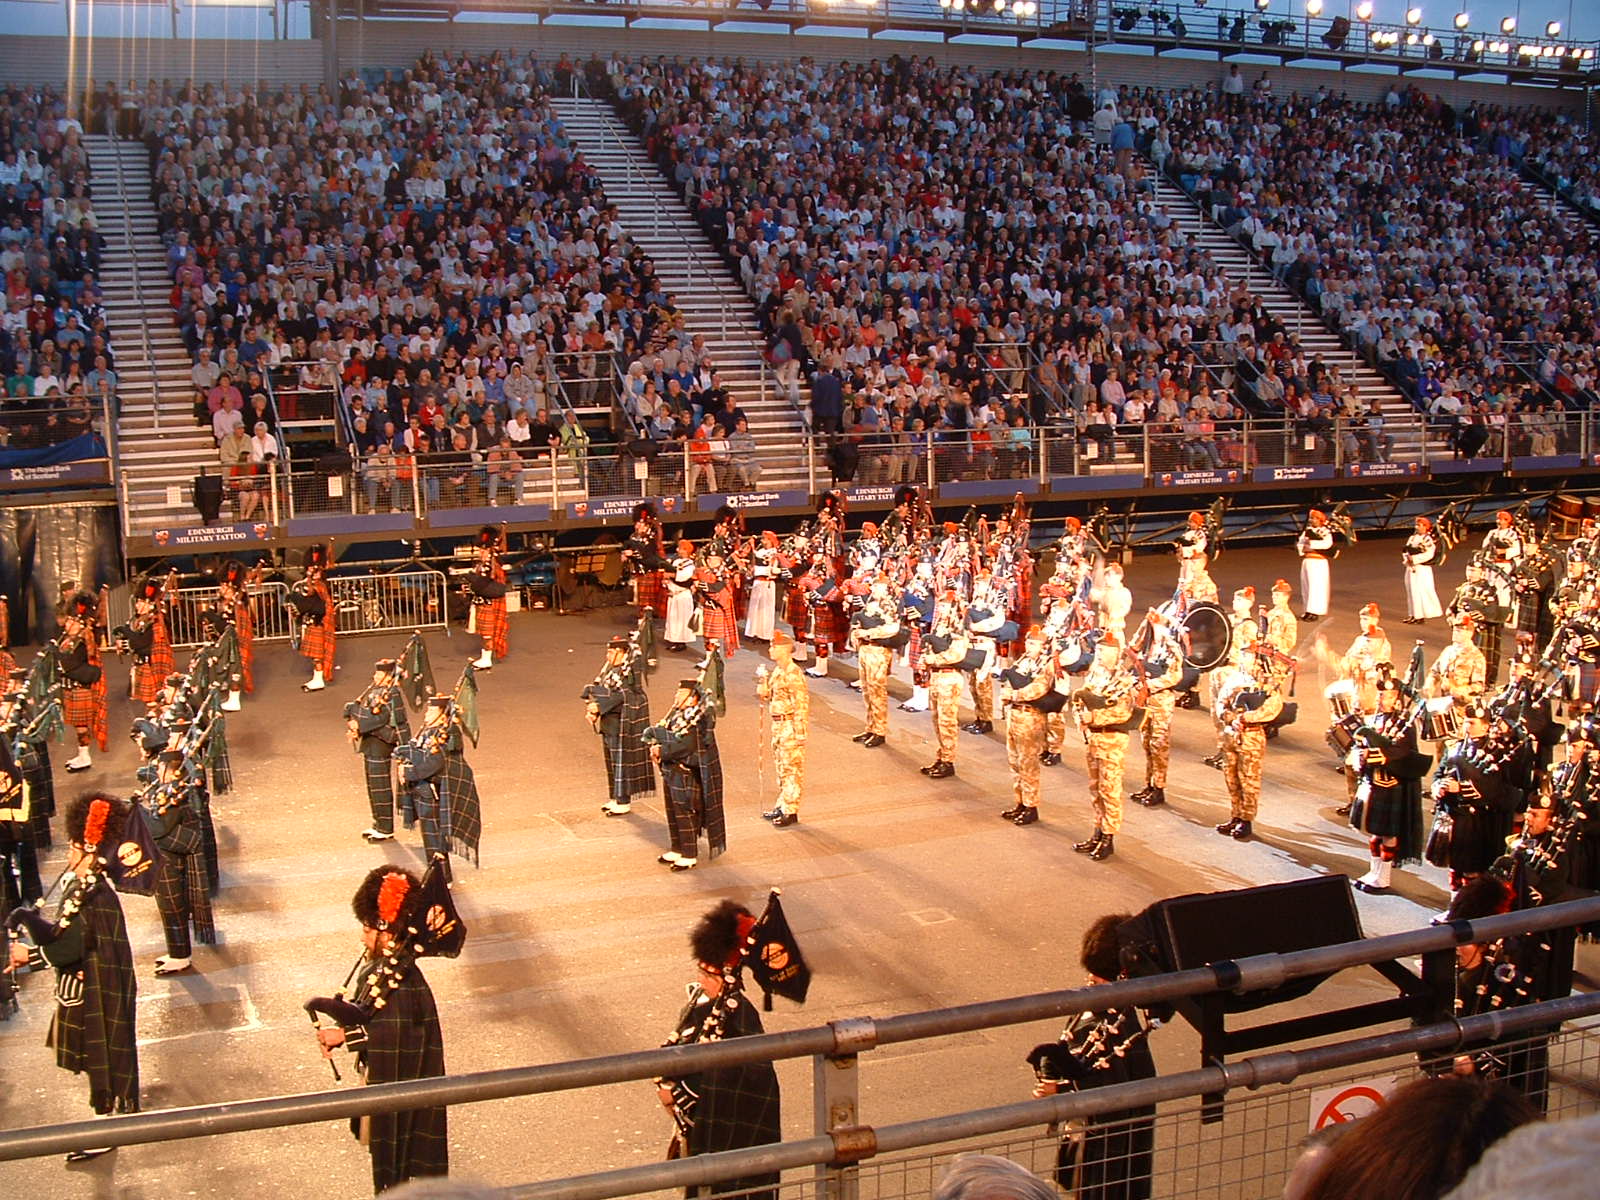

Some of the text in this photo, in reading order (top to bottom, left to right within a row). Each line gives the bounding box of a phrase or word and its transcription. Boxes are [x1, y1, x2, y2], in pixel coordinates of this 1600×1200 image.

[593, 507, 628, 515] MILITARY
[188, 527, 234, 535] EDINBURGH
[176, 535, 214, 543] MILITARY
